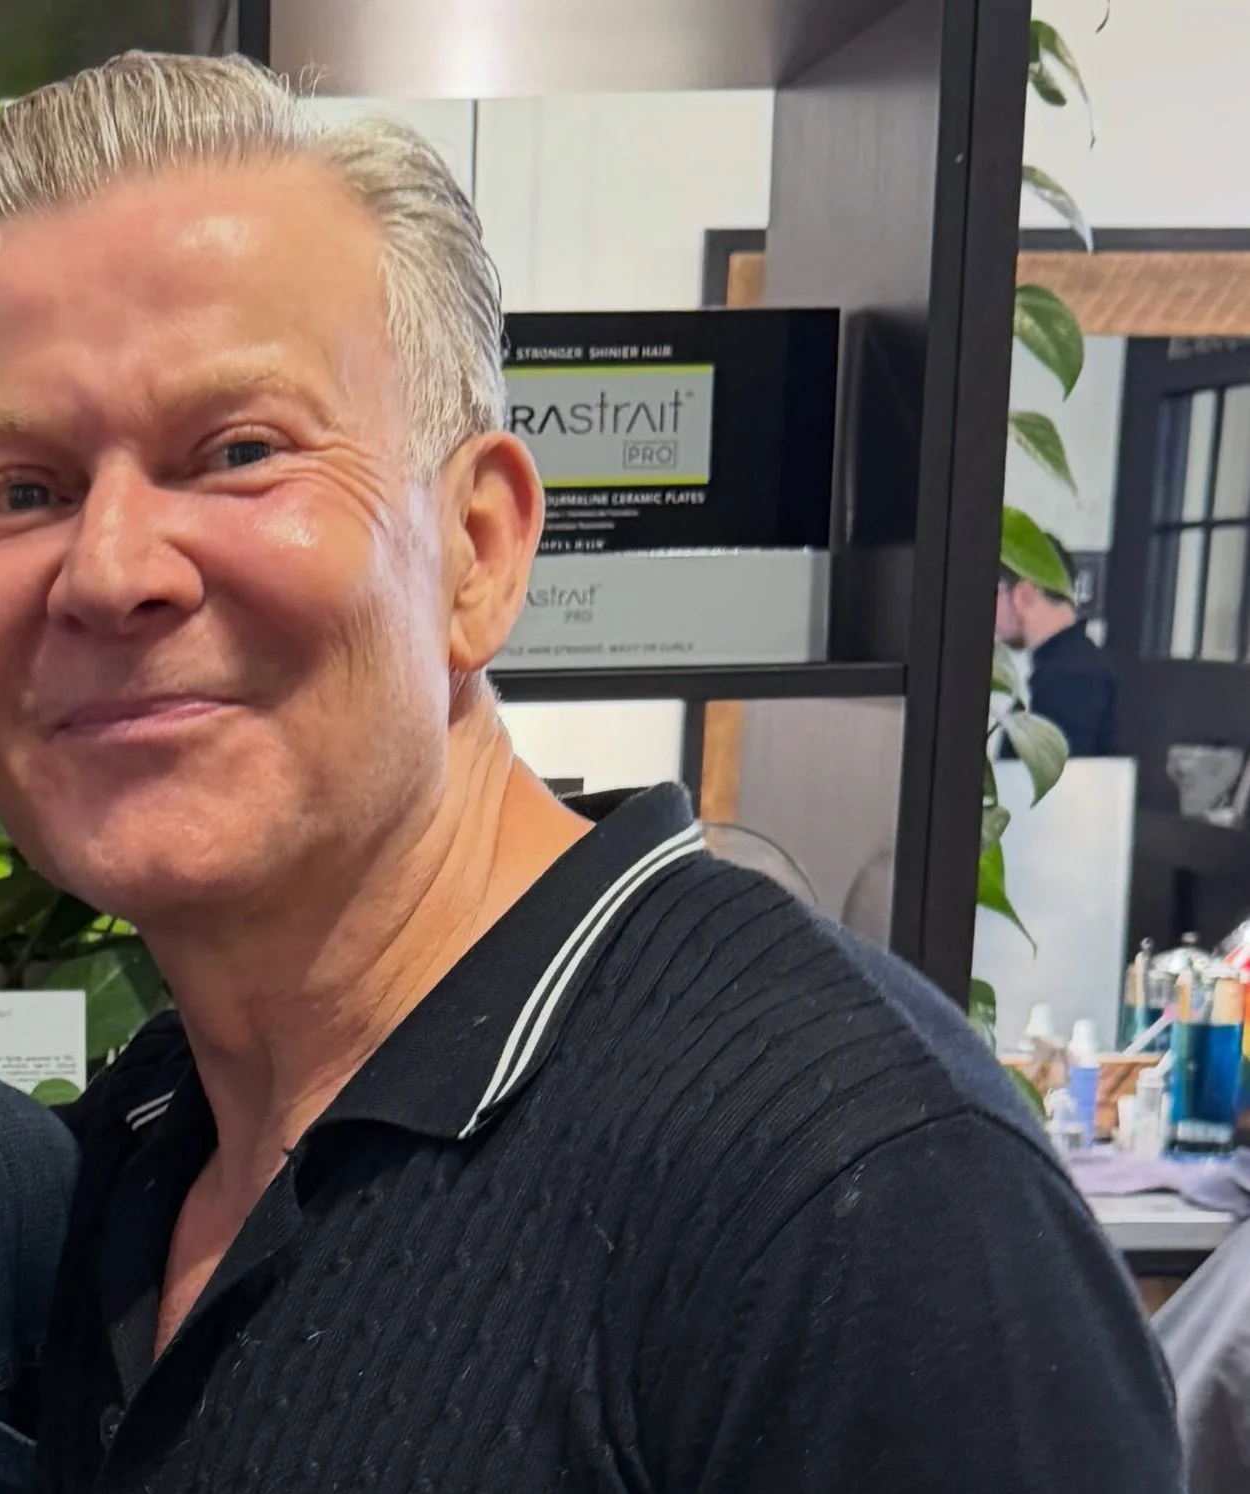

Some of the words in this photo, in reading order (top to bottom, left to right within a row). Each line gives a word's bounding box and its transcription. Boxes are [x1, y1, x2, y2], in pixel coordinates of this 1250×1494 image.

[516, 347, 582, 360] STRONGER
[588, 346, 639, 359] SHINIER
[642, 345, 673, 357] HAIR
[627, 445, 672, 464] PRO
[611, 492, 662, 505] CERAMIC
[665, 491, 705, 504] PLATES
